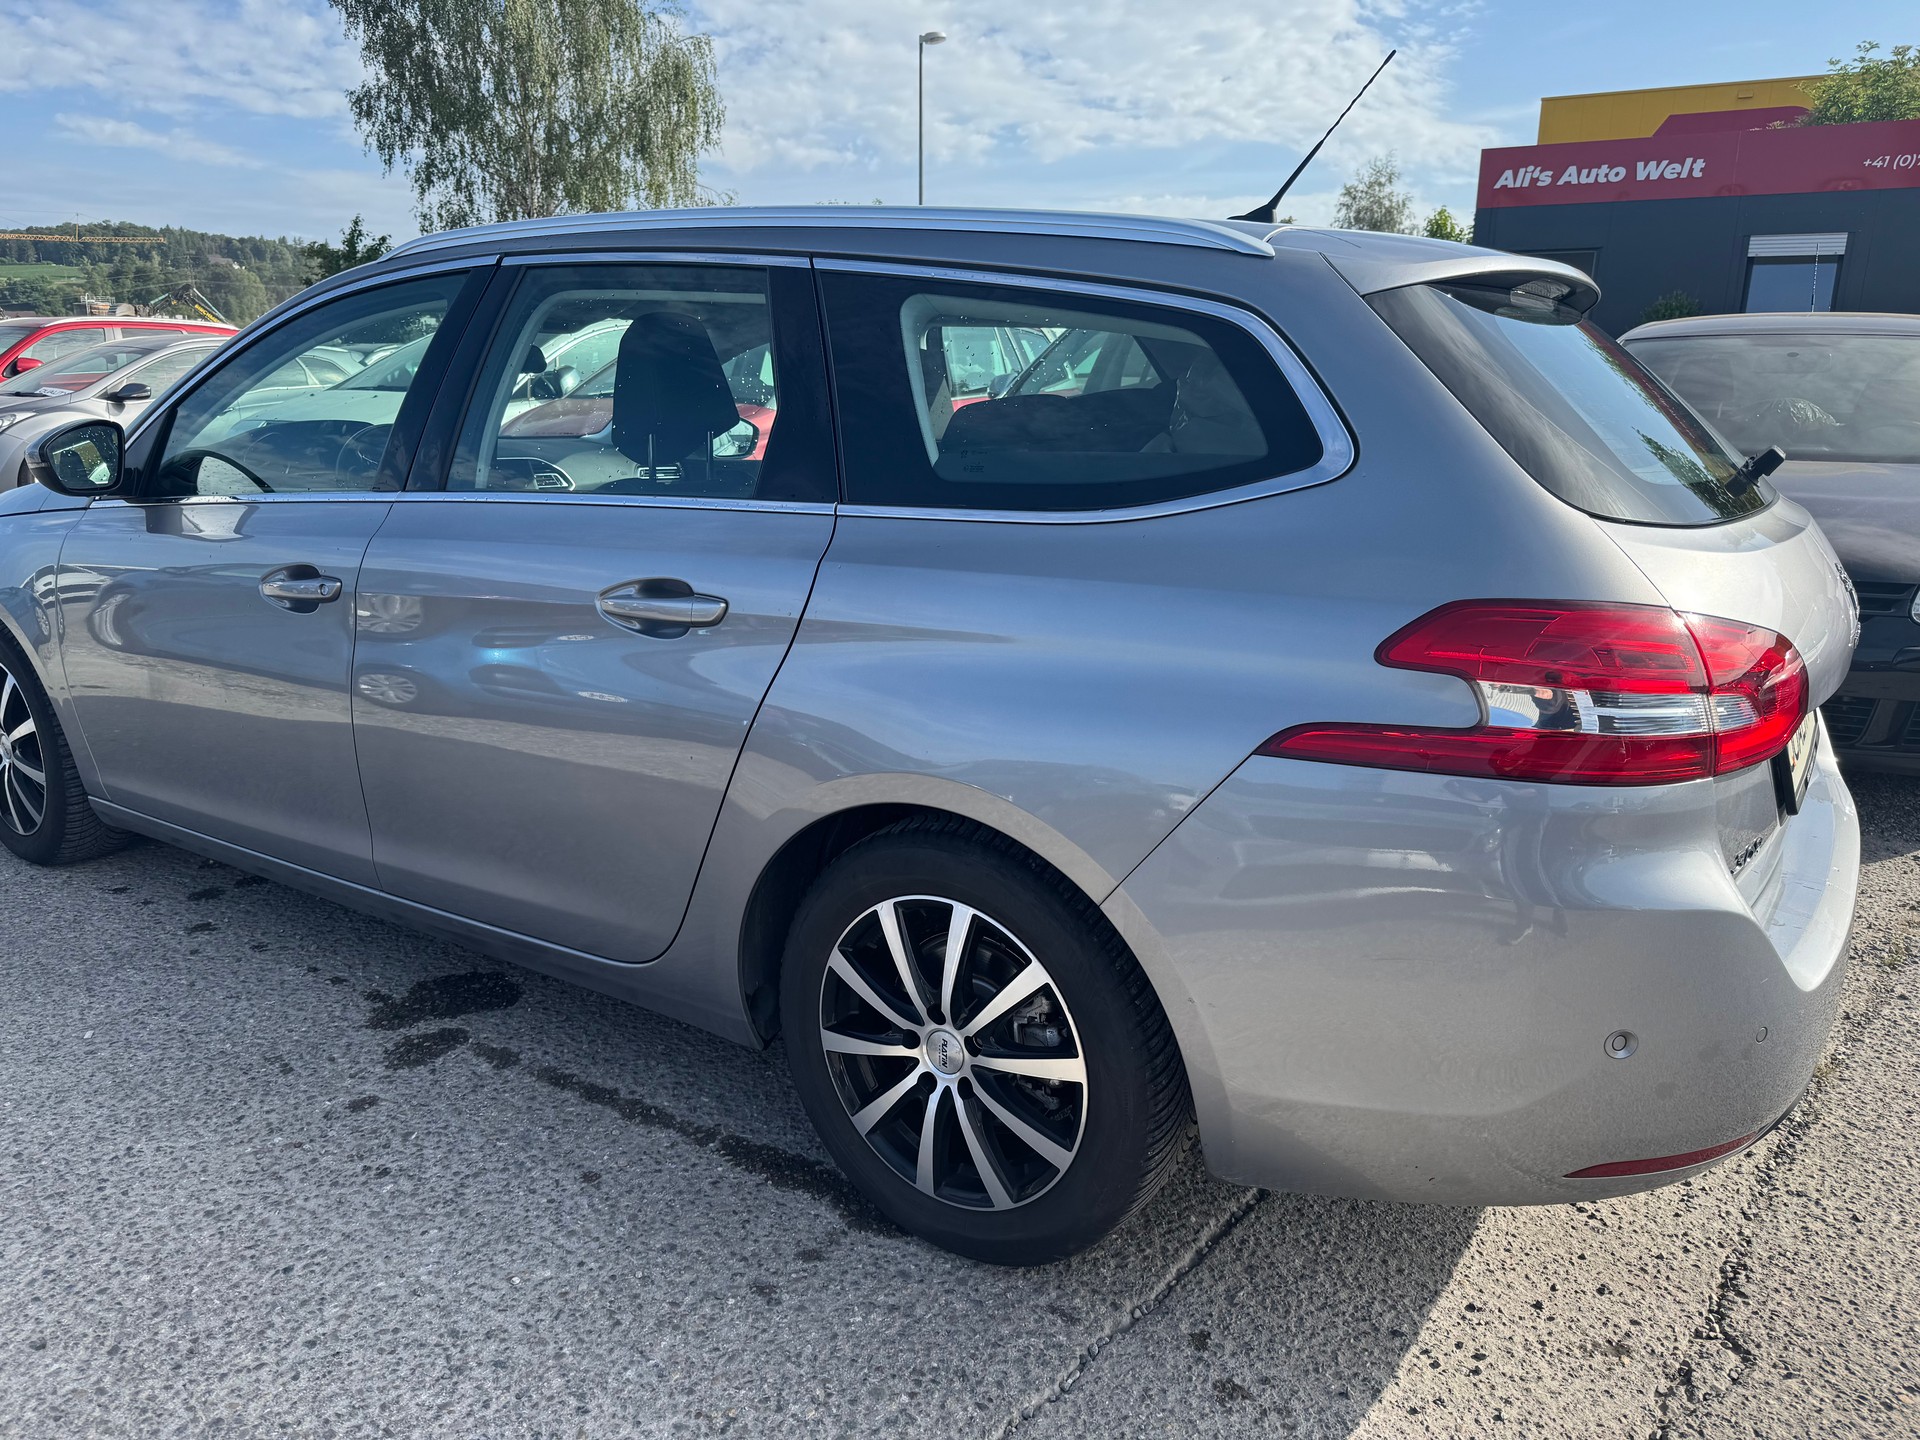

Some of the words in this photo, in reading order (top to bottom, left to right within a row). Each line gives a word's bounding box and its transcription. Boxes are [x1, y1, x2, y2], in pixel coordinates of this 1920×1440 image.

[1493, 165, 1554, 189] Ali's
[1556, 164, 1627, 186] Auto
[1636, 157, 1706, 181] Welt
[1863, 155, 1891, 168] +41
[1893, 153, 1920, 170] (0)
